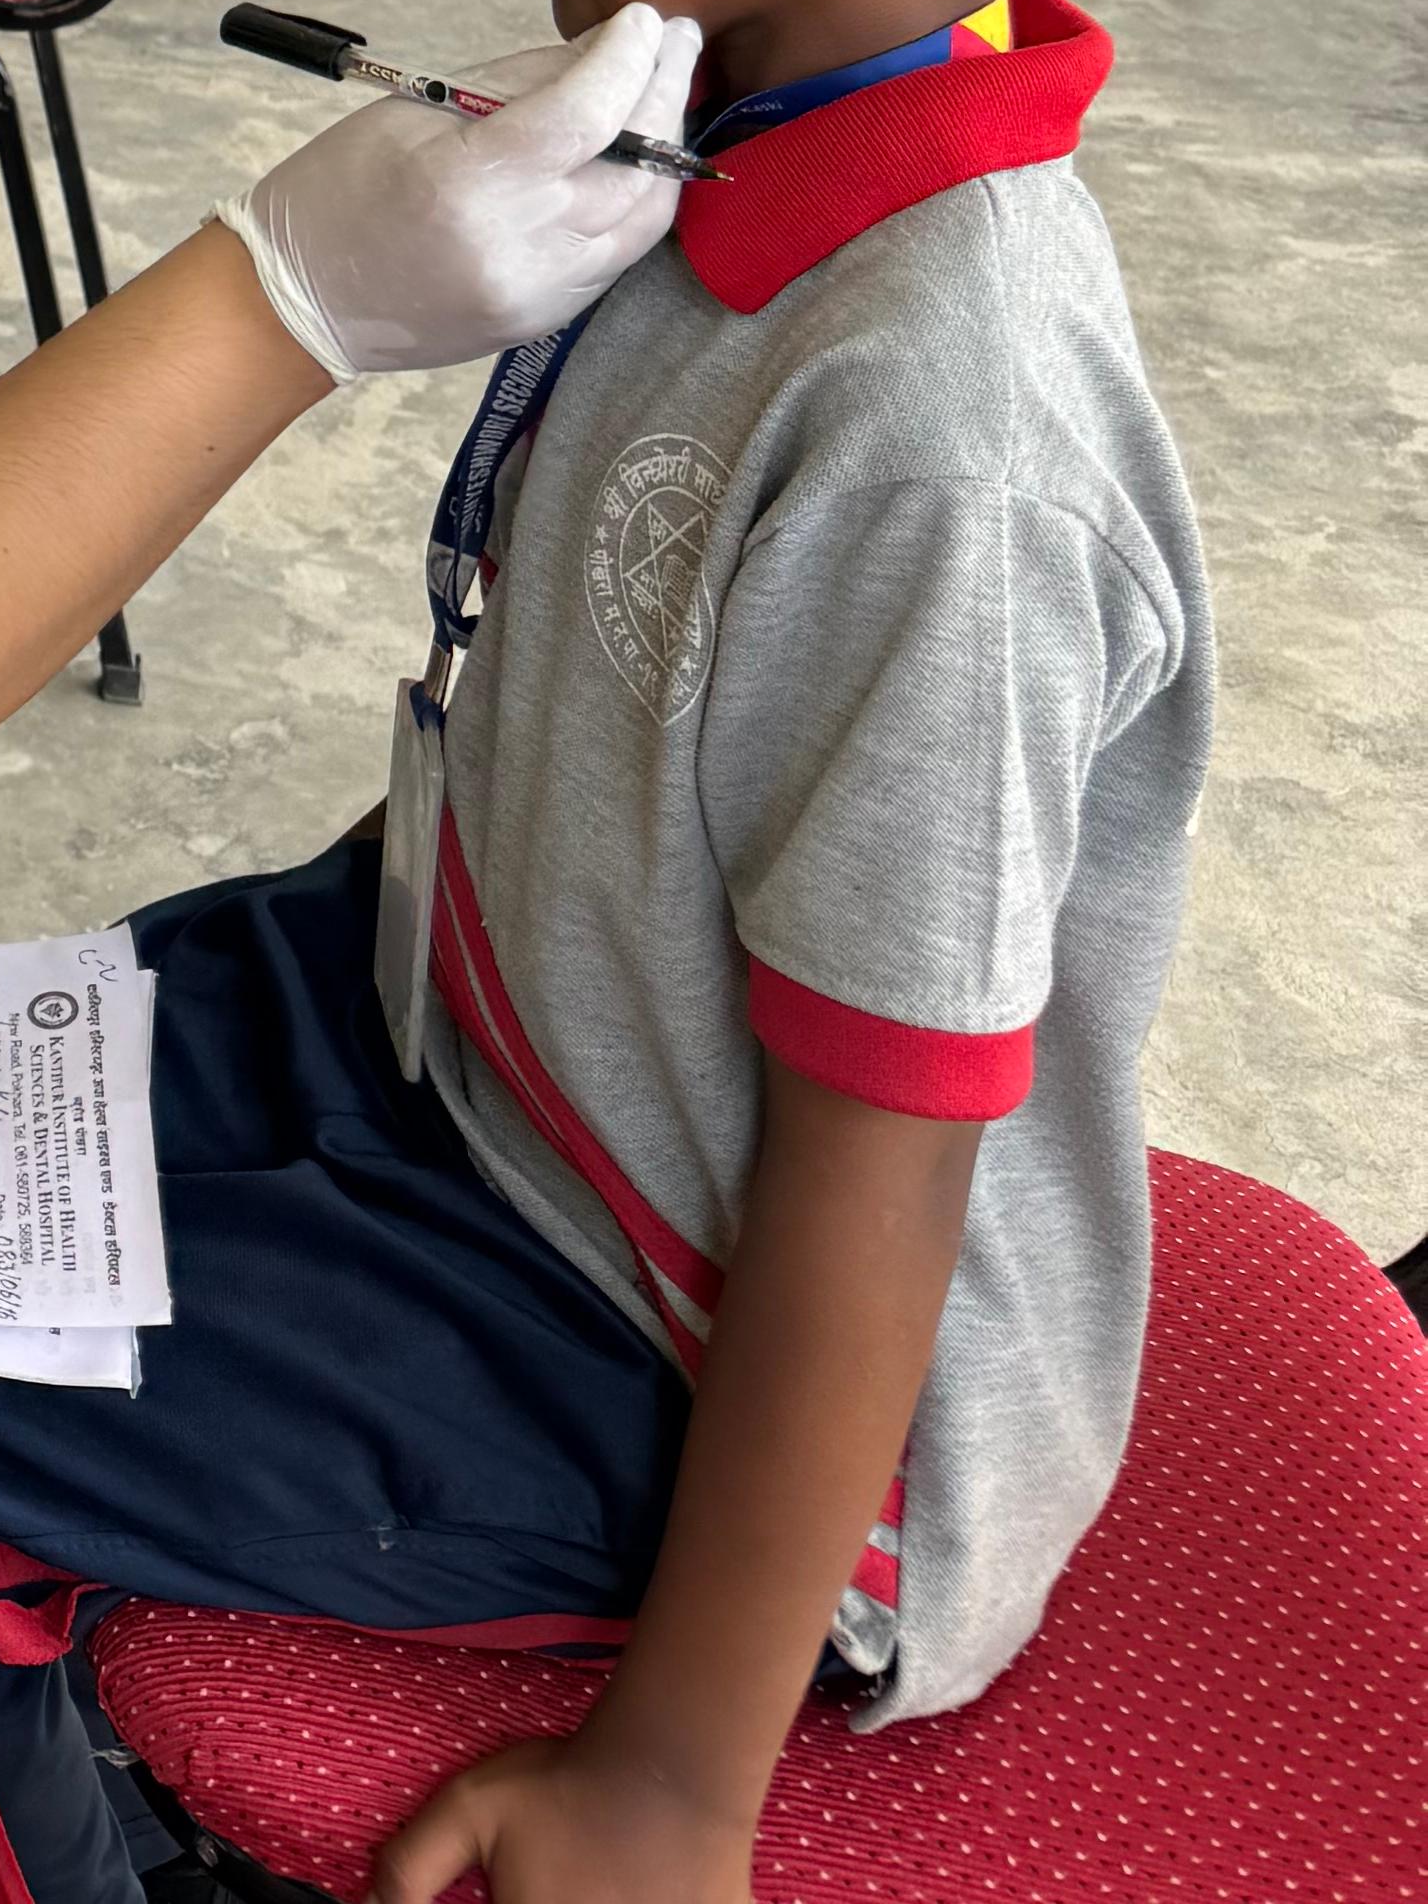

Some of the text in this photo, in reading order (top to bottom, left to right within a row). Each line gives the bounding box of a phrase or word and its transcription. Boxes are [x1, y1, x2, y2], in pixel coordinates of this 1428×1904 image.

[30, 1045, 55, 1265] SCIENCES & DENTAL HOSPITAL
[49, 1036, 76, 1272] KANTIPUR INSTITUTE OF HEALTH
